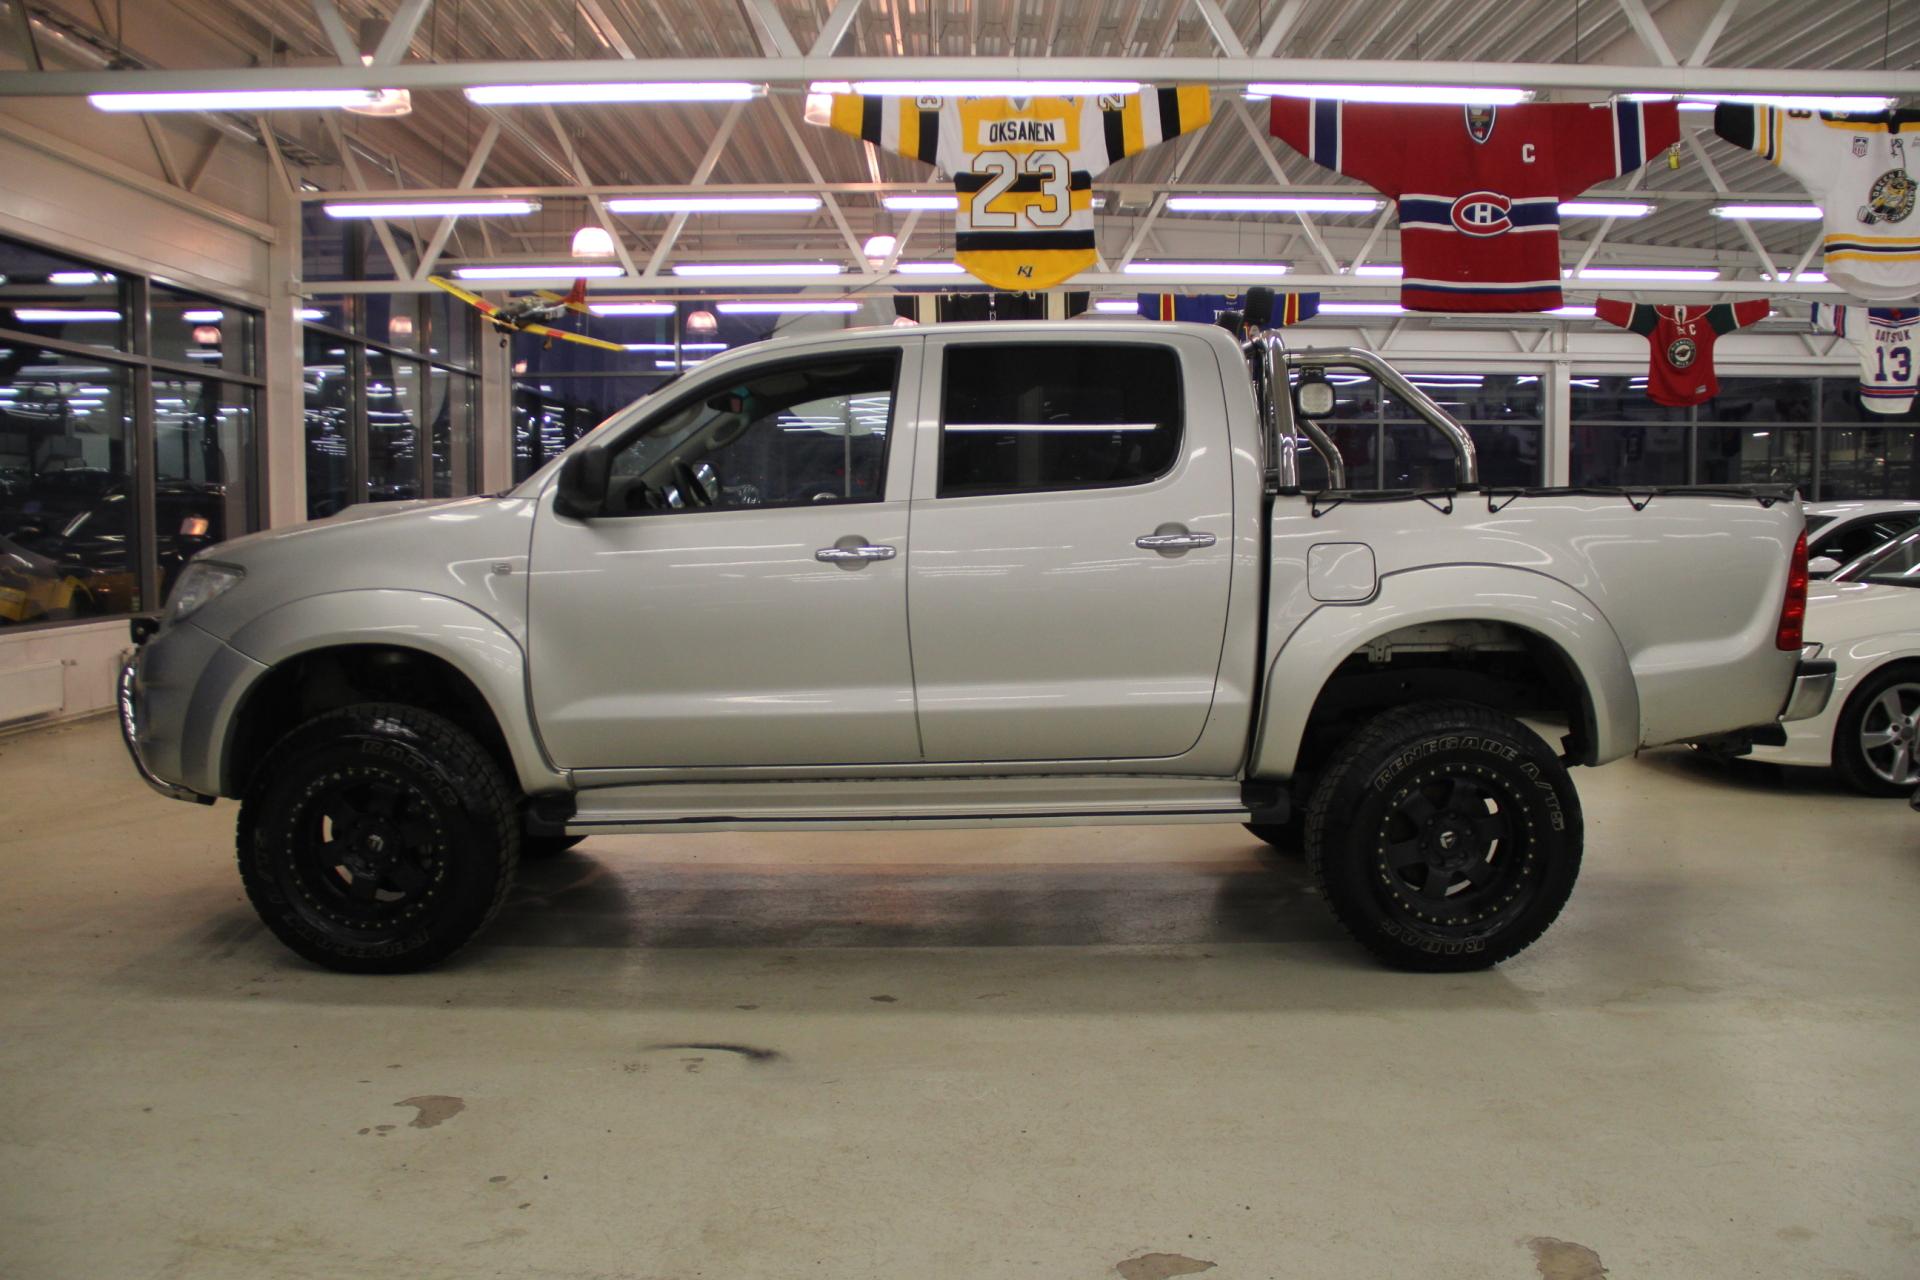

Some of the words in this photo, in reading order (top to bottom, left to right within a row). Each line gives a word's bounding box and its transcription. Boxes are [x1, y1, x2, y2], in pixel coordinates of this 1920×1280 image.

[989, 121, 1055, 143] OKSANEN
[1522, 143, 1536, 163] C
[971, 150, 1072, 228] 23
[1688, 323, 1697, 336] C
[1874, 345, 1912, 382] 13
[1374, 736, 1518, 792] RENEGADE
